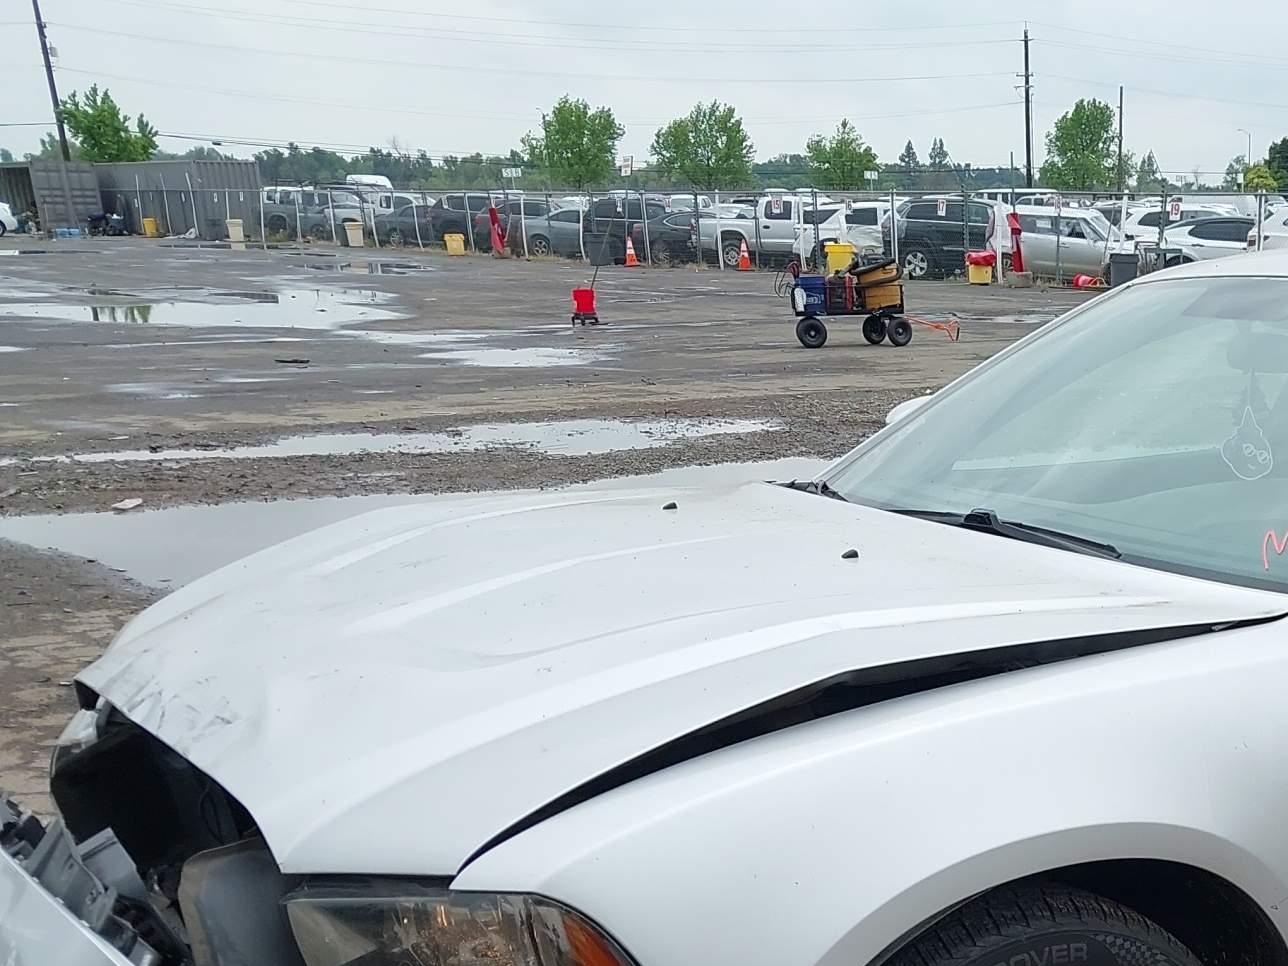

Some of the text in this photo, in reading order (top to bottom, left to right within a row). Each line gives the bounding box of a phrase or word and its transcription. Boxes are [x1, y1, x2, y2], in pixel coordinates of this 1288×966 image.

[772, 199, 780, 209] 15
[938, 200, 946, 212] 17
[1170, 203, 1181, 216] 19
